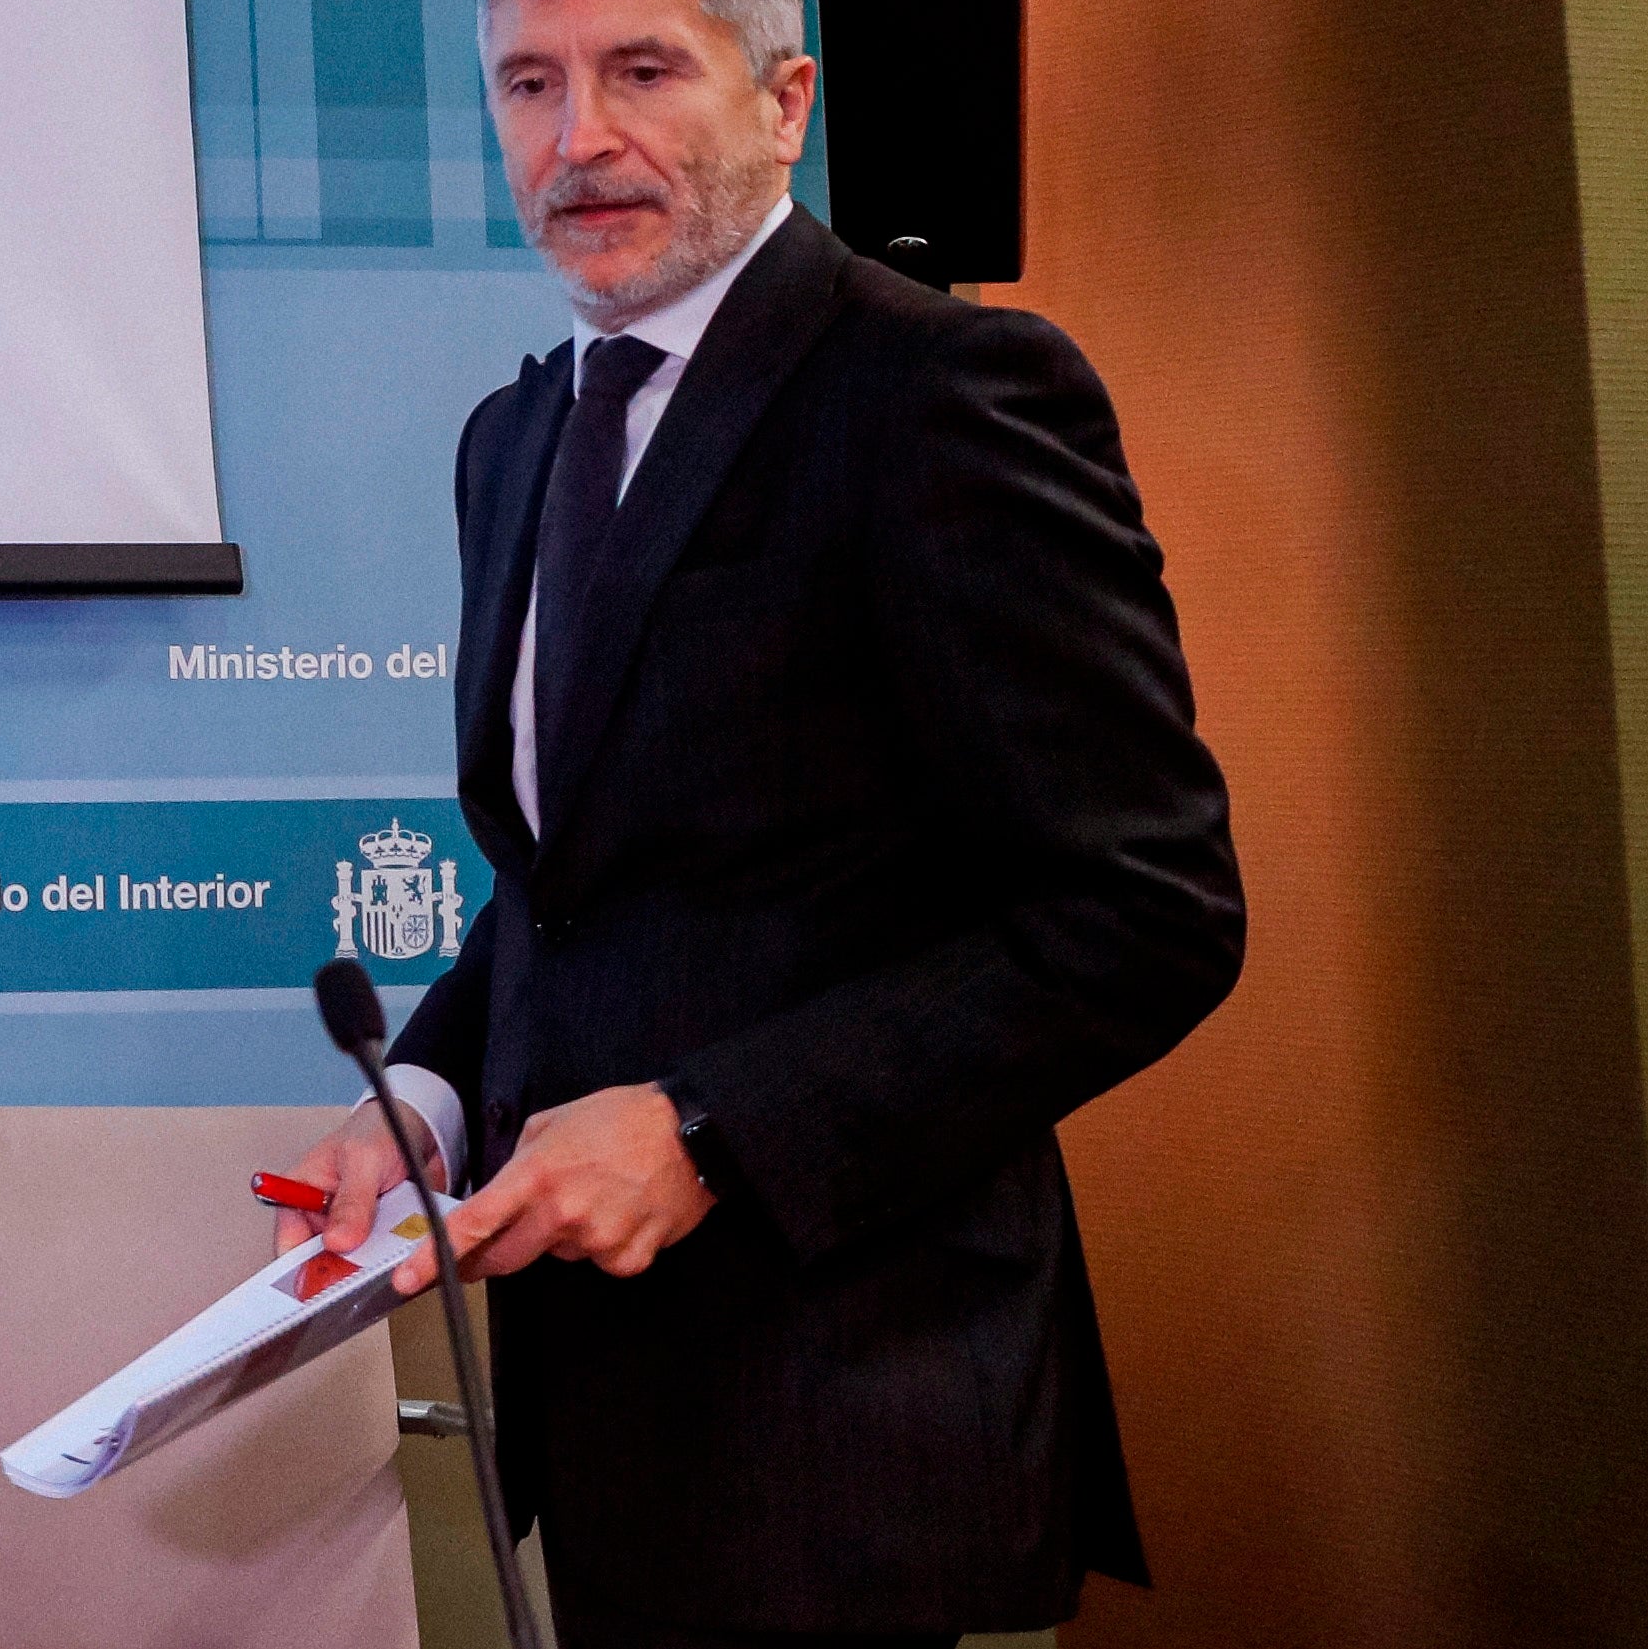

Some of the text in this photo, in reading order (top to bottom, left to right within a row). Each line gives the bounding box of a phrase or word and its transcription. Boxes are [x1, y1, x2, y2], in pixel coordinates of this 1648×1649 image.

[169, 644, 448, 681] Ministerio del
[43, 875, 106, 913] del
[119, 873, 272, 911] Interior
